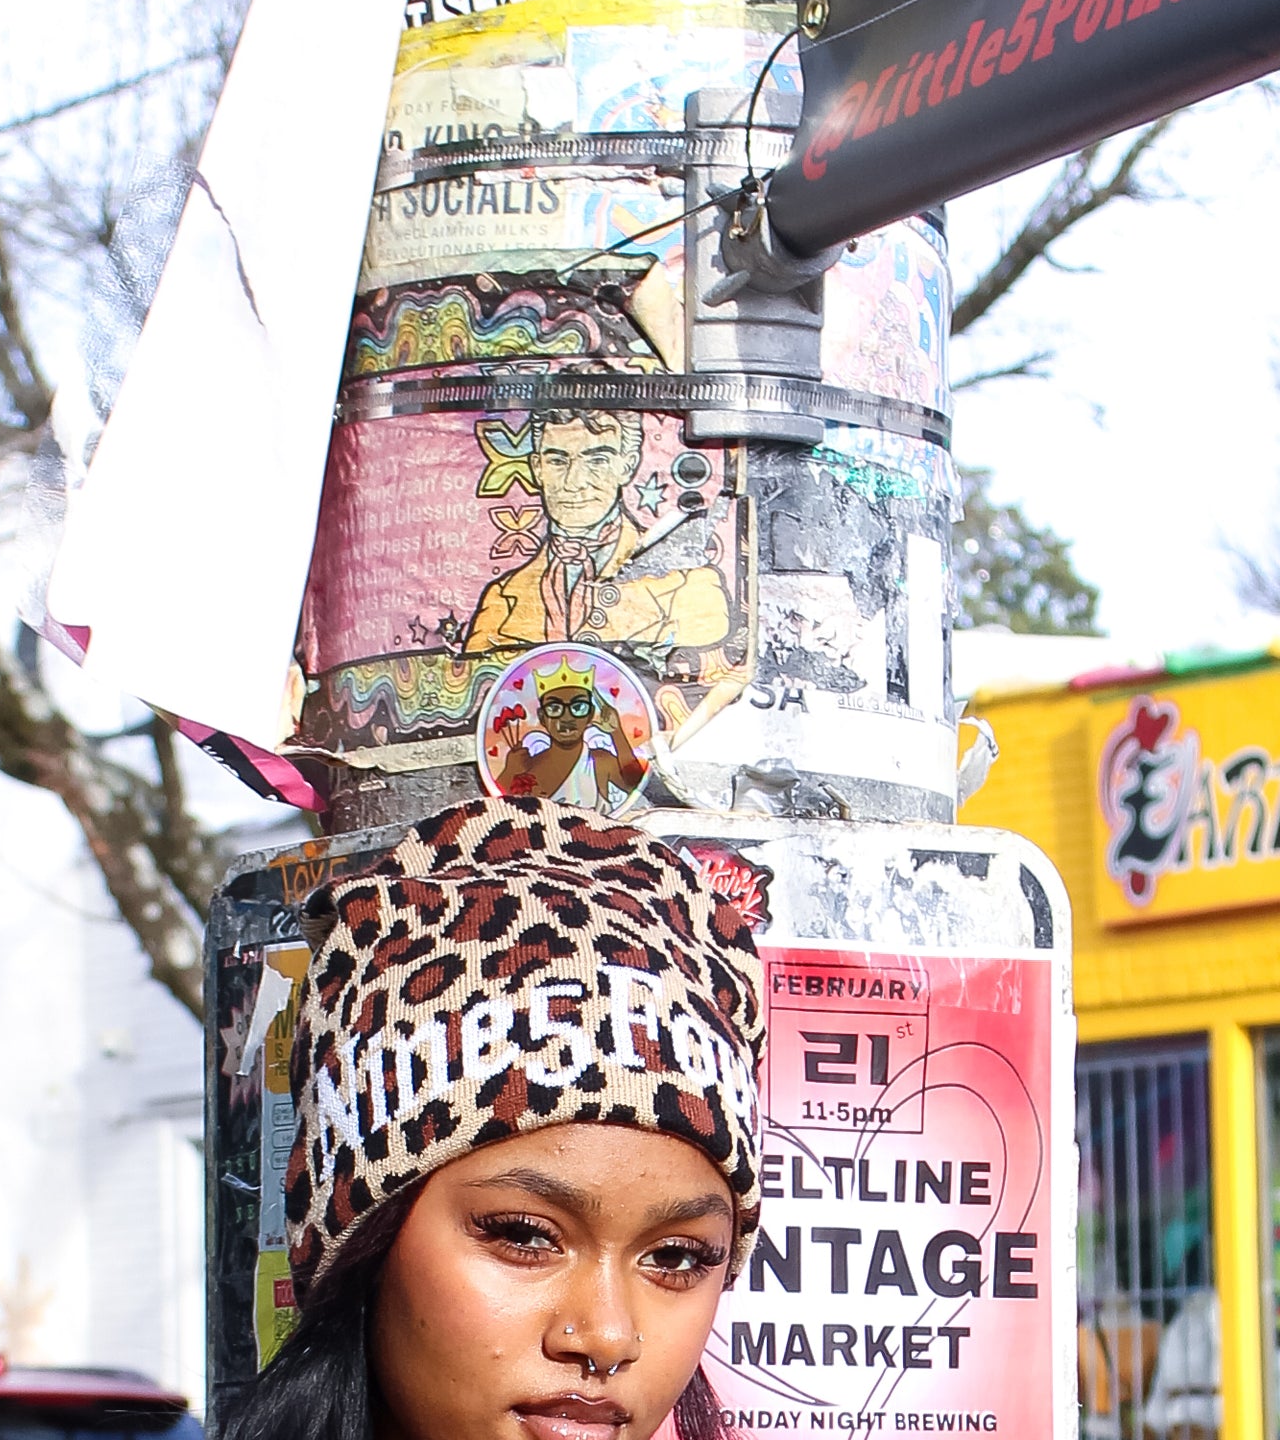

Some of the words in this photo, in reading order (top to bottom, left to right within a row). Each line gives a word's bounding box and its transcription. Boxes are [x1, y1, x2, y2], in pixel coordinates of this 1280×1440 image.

[772, 973, 923, 1001] FEBRUARY
[316, 960, 762, 1182] Nine5Fou
[797, 1030, 890, 1086] 21
[895, 1021, 915, 1039] st
[730, 1321, 971, 1370] MARKET
[809, 1410, 887, 1432] NIGHT
[894, 1412, 998, 1433] BREWING
